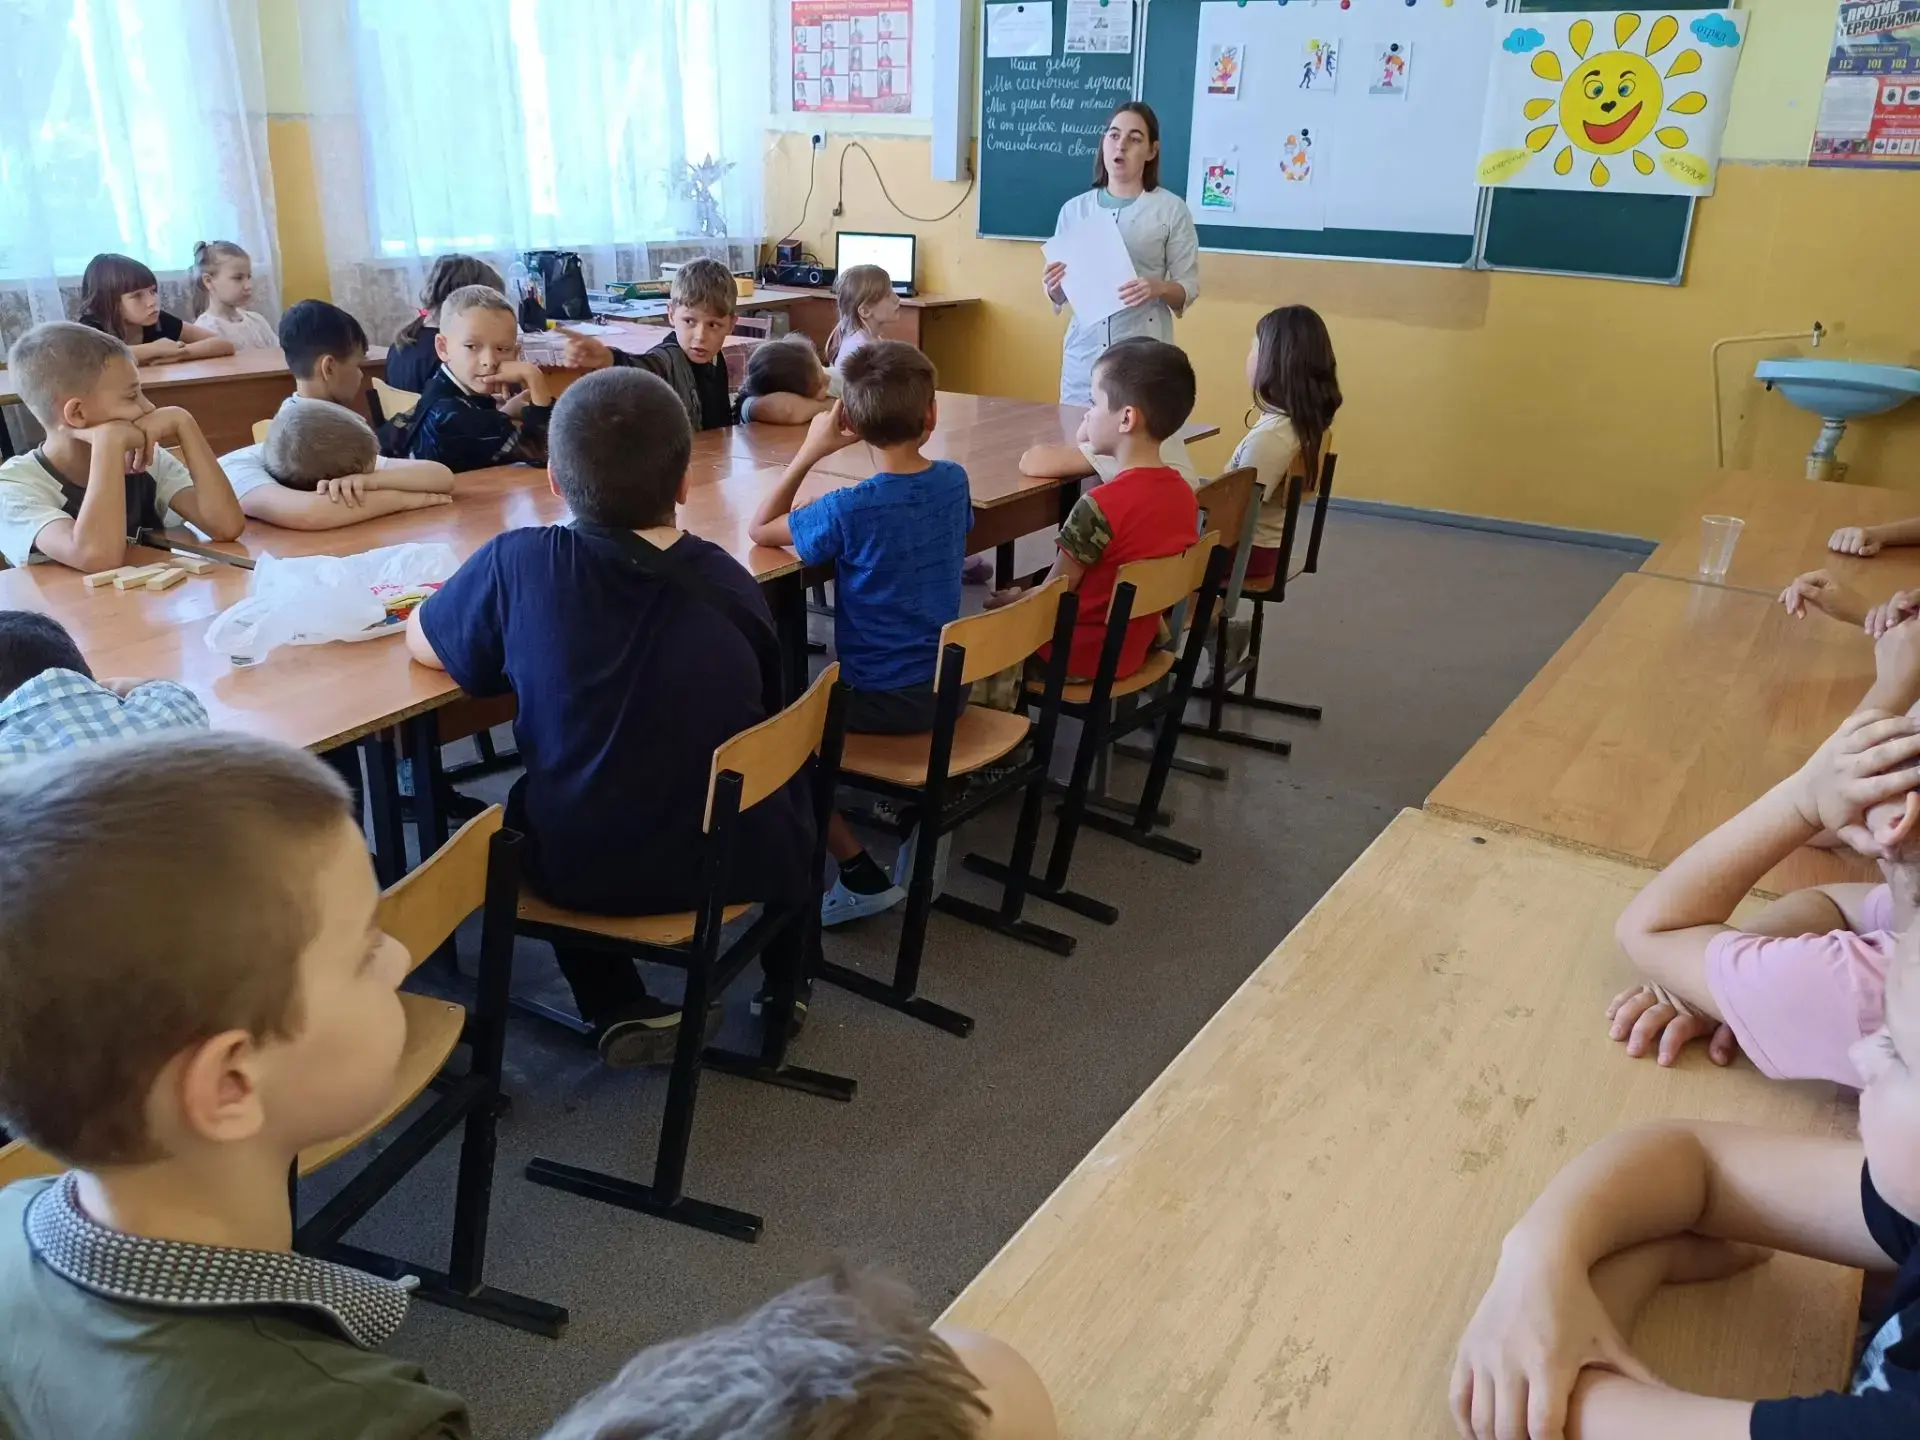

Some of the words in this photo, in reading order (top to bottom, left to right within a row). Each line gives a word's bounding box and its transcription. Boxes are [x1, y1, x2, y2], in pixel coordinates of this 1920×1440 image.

[1847, 0, 1901, 22] ПРОТИВ
[1045, 55, 1082, 76] девиз
[1838, 59, 1853, 69] 112
[1867, 59, 1883, 69] 101
[1891, 58, 1907, 69] 102
[985, 96, 1007, 114] Мы
[1010, 97, 1047, 117] дарим
[986, 116, 996, 130] И
[1000, 123, 1014, 131] от
[1017, 114, 1057, 136] улыбок
[986, 133, 1064, 155] Становится
